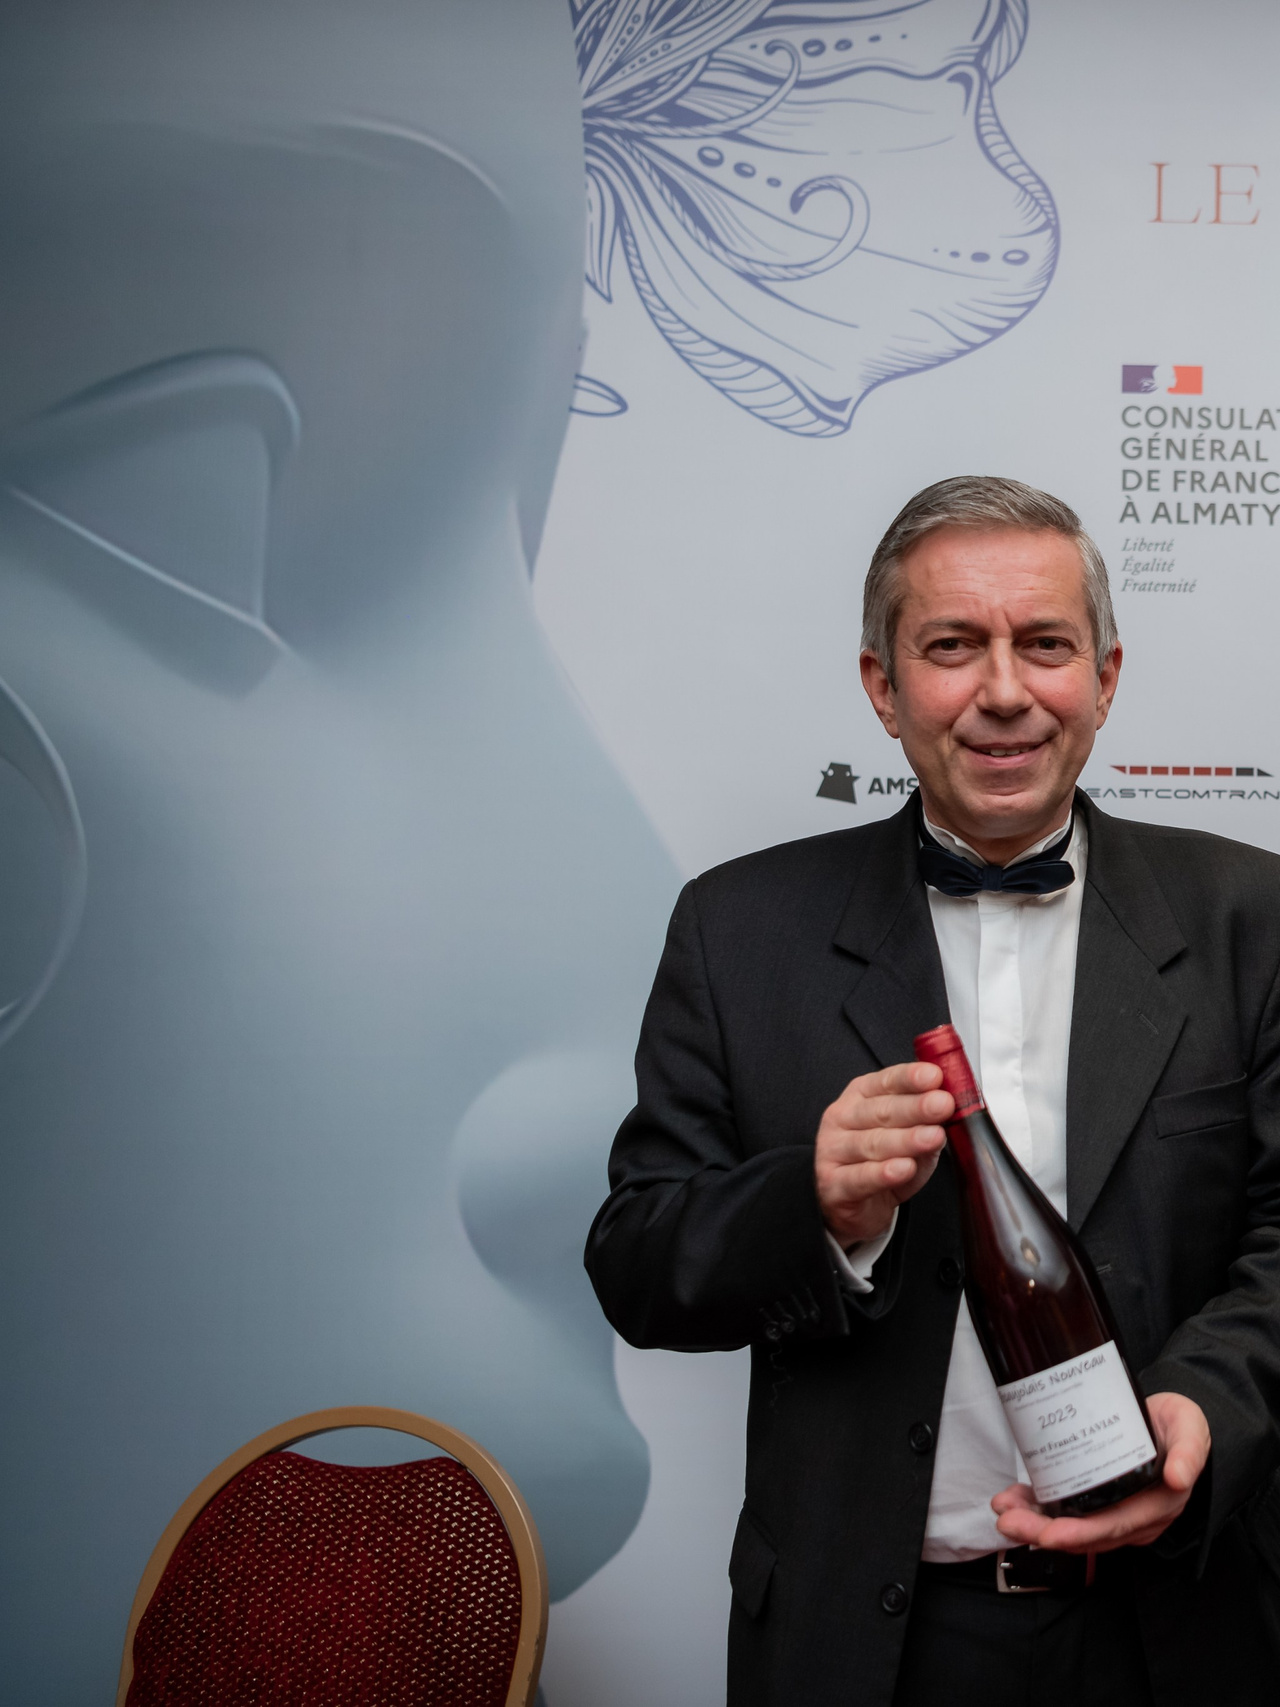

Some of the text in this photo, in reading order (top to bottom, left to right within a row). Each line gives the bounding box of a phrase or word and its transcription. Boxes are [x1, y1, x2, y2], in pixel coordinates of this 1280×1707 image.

[1149, 162, 1261, 226] LE
[1120, 432, 1269, 463] GÉNÉRAL
[1121, 468, 1161, 493] DE
[1119, 495, 1141, 524] À
[1121, 537, 1175, 553] Liberté
[1121, 555, 1175, 576] Égalité
[1121, 578, 1197, 594] Fraternité
[1049, 1353, 1107, 1386] Nouveau
[1036, 1402, 1078, 1431] 2023
[1081, 1412, 1121, 1438] TAVIAN
